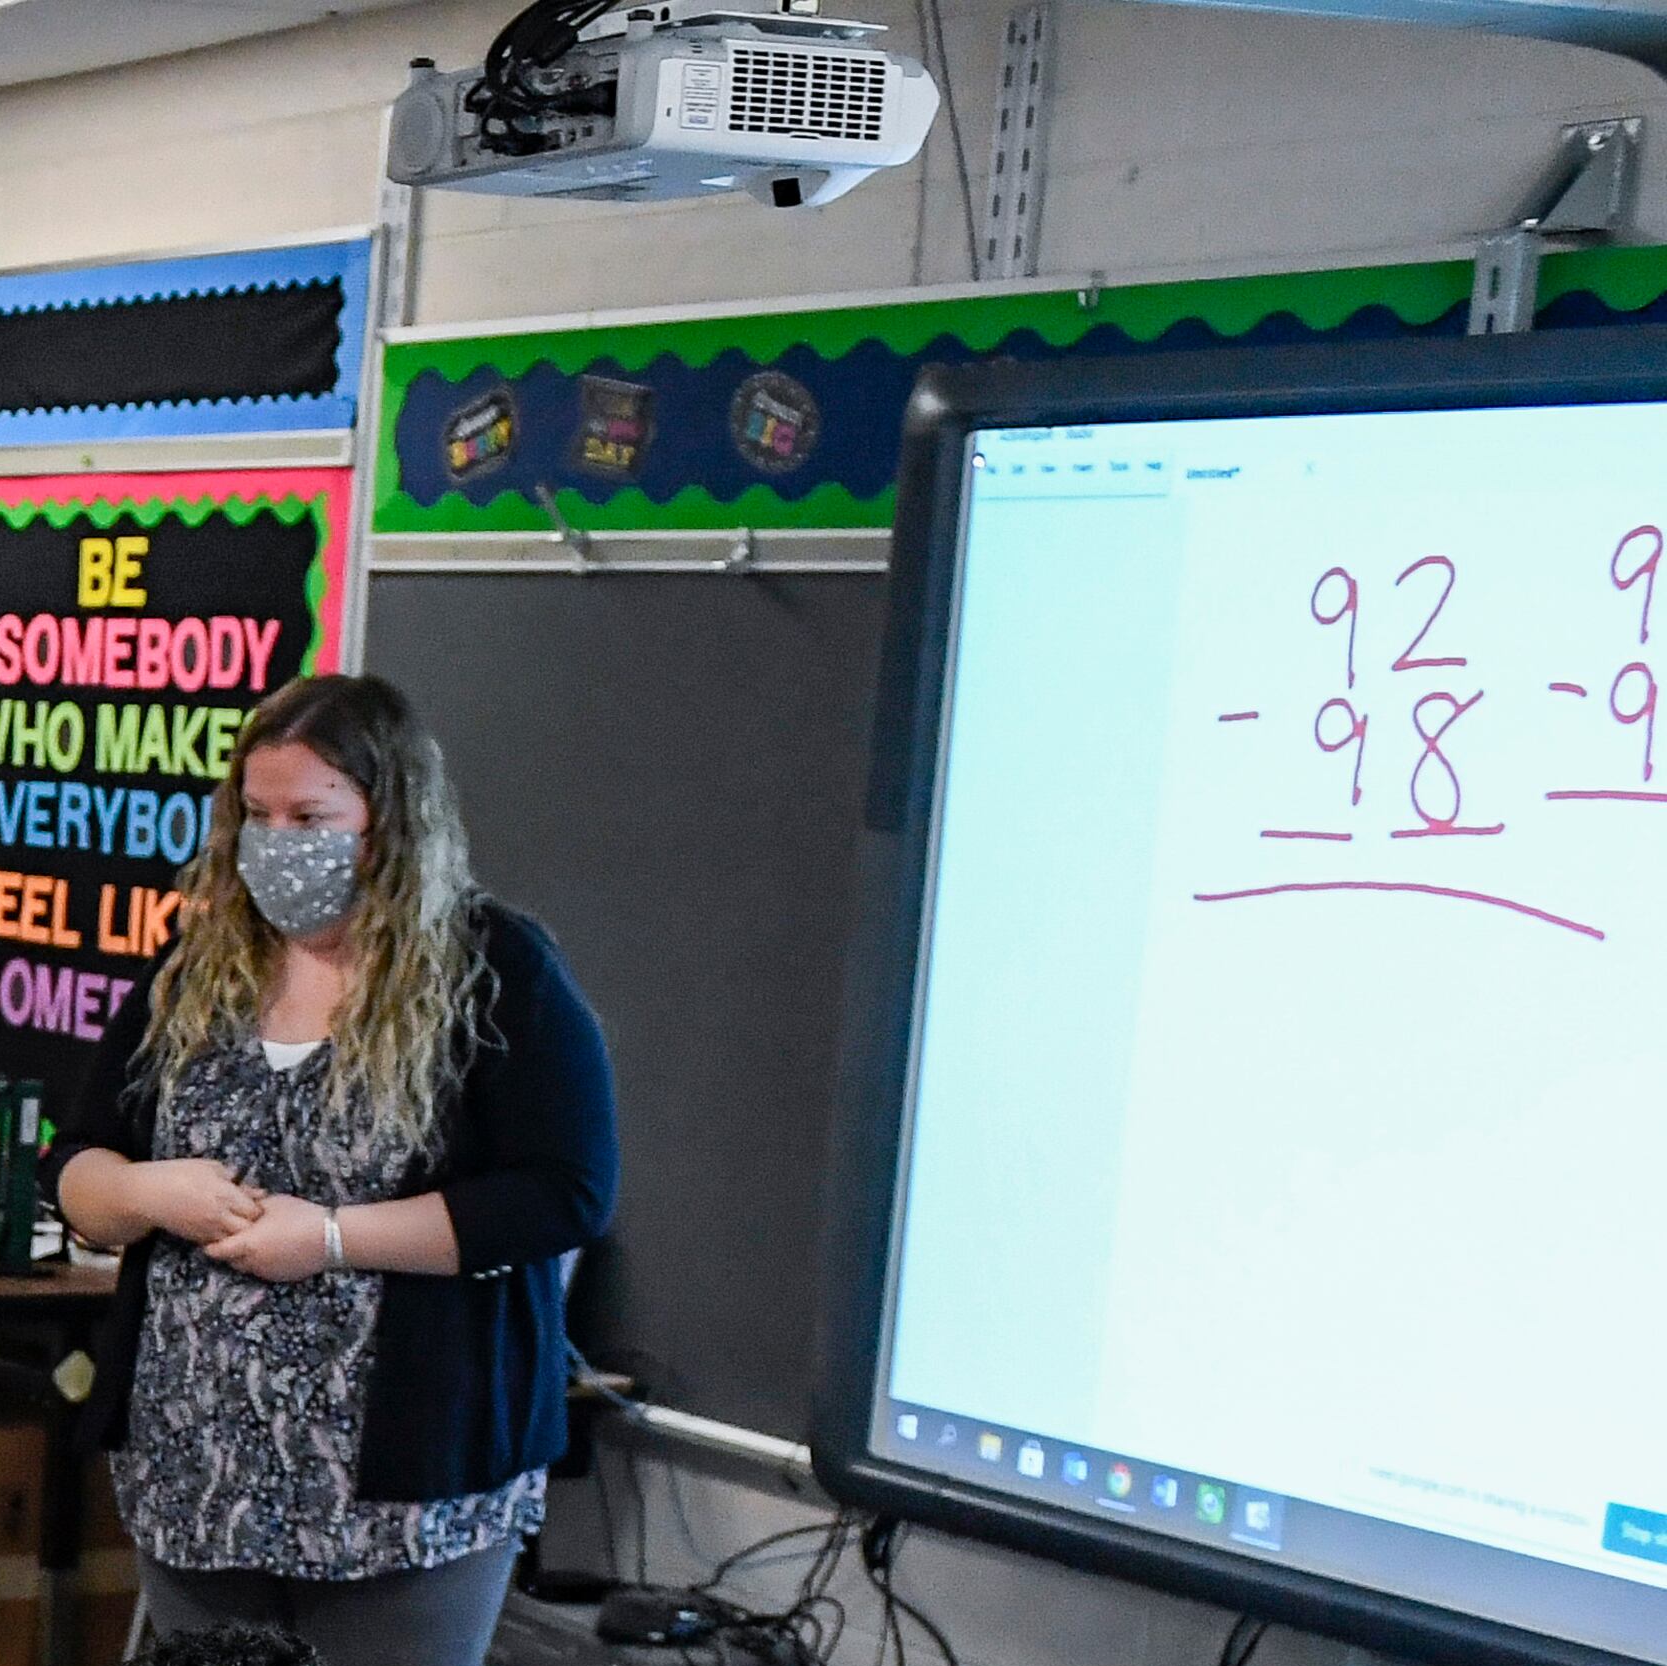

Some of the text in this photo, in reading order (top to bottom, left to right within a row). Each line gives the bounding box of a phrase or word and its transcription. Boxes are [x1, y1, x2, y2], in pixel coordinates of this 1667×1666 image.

[77, 536, 149, 608] BE
[1311, 555, 1467, 689] 92
[94, 702, 259, 780] MAKE
[98, 883, 212, 958] LIK
